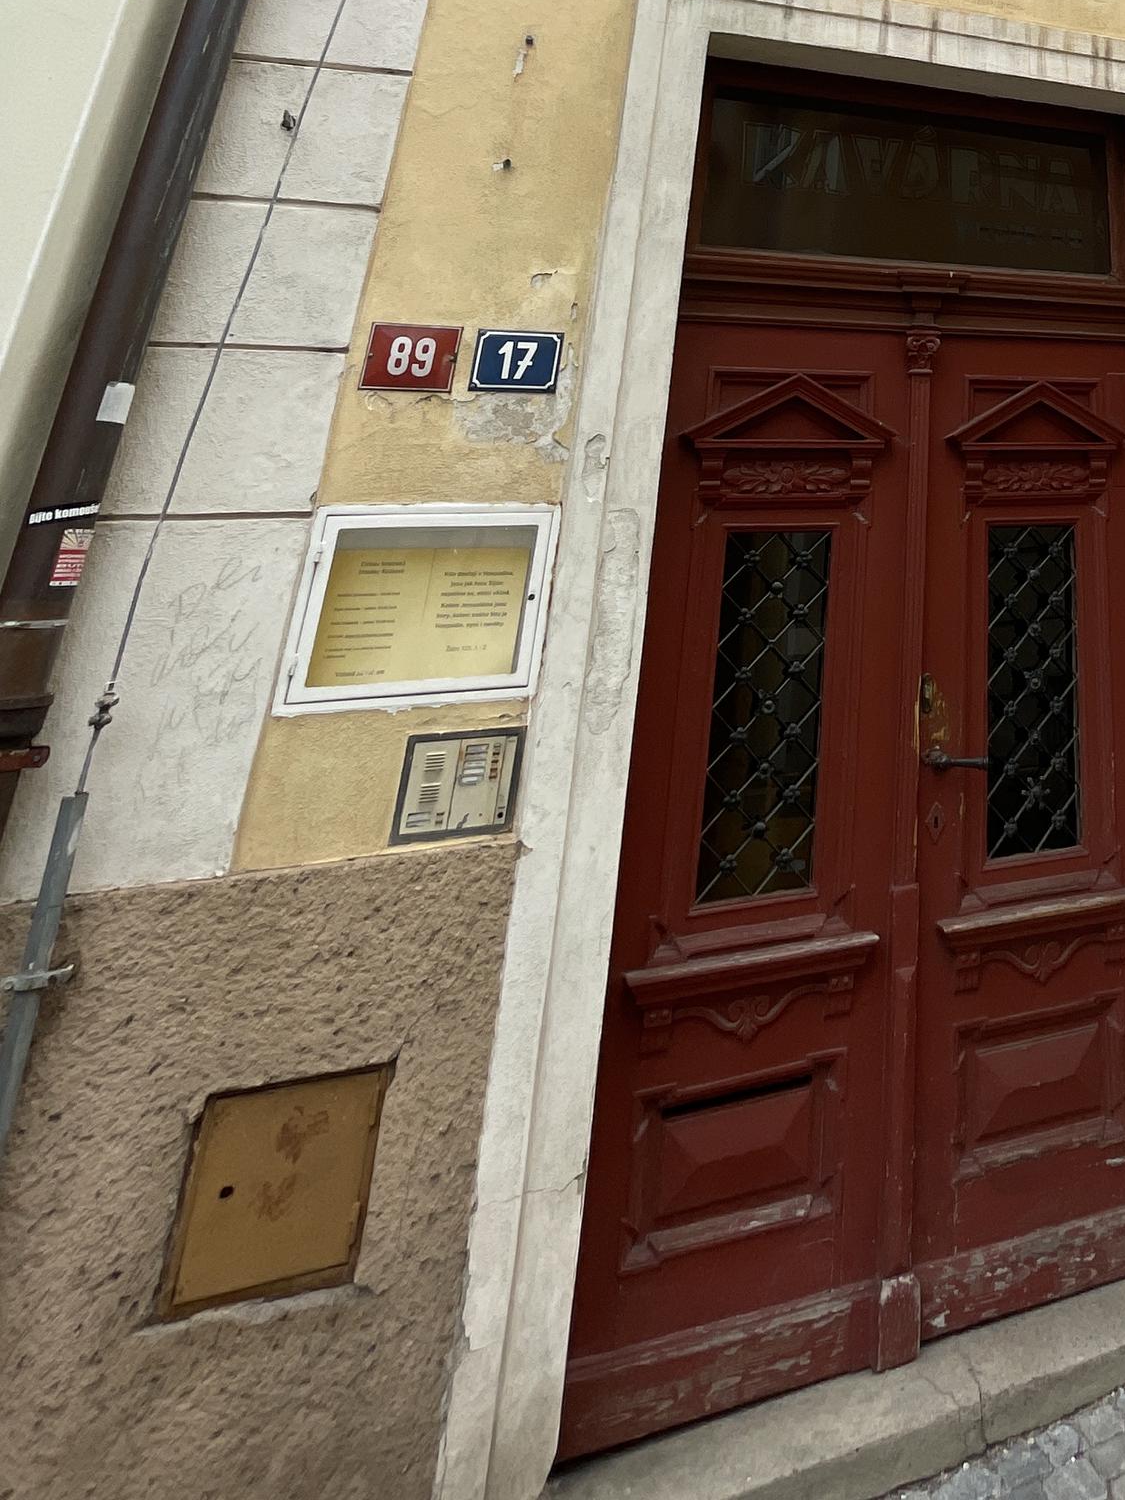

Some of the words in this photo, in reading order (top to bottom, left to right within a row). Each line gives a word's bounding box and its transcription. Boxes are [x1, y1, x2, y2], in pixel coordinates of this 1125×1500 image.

[741, 120, 1085, 217] KAVÁRNA
[386, 336, 437, 378] 89
[497, 341, 539, 380] 17
